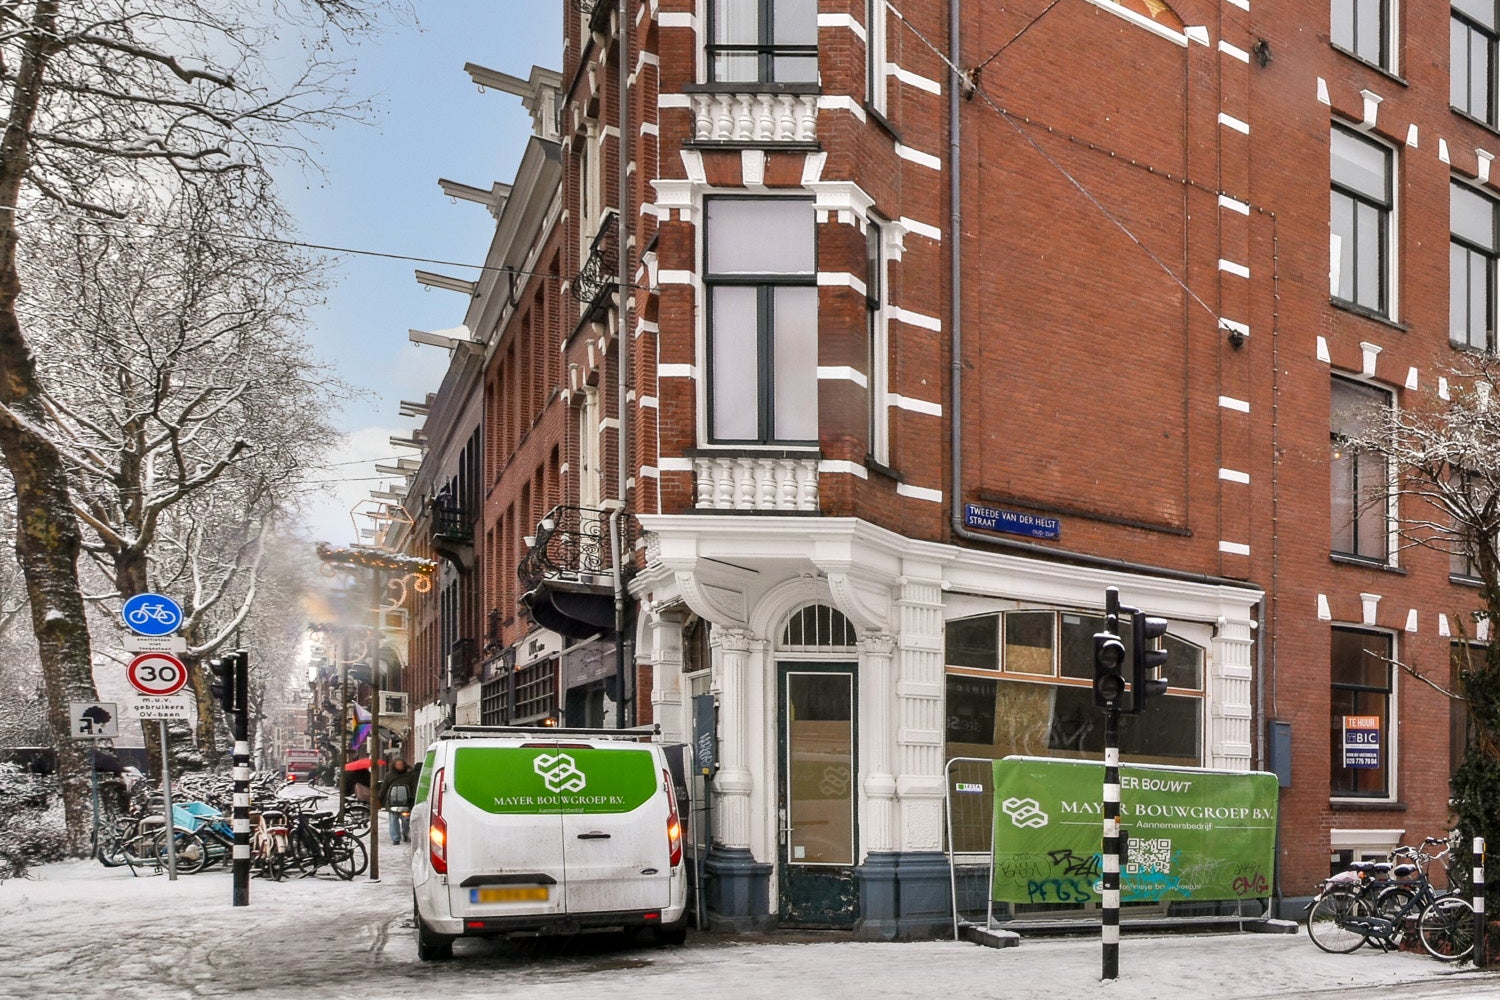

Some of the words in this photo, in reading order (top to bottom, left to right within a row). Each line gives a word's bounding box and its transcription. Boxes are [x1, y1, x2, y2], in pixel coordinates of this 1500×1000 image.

[969, 506, 1000, 519] TWEEDE
[1002, 511, 1017, 522] VAN
[1019, 515, 1034, 525] DER
[1035, 518, 1056, 529] HELST
[969, 516, 997, 528] STRAAT
[140, 666, 177, 682] 30
[1348, 718, 1357, 727] TE
[1357, 718, 1375, 727] HUUR
[1356, 733, 1377, 743] BIC
[1142, 779, 1192, 793] BOUWT
[494, 796, 534, 806] MAYER
[537, 796, 607, 805] BOUWGROEP
[609, 796, 626, 805] B.V.
[1060, 801, 1129, 815] MAYR
[1135, 804, 1250, 819] BOUWGROEP
[1252, 808, 1274, 820] B.V.
[1136, 820, 1213, 831] Aannemersbedrijf
